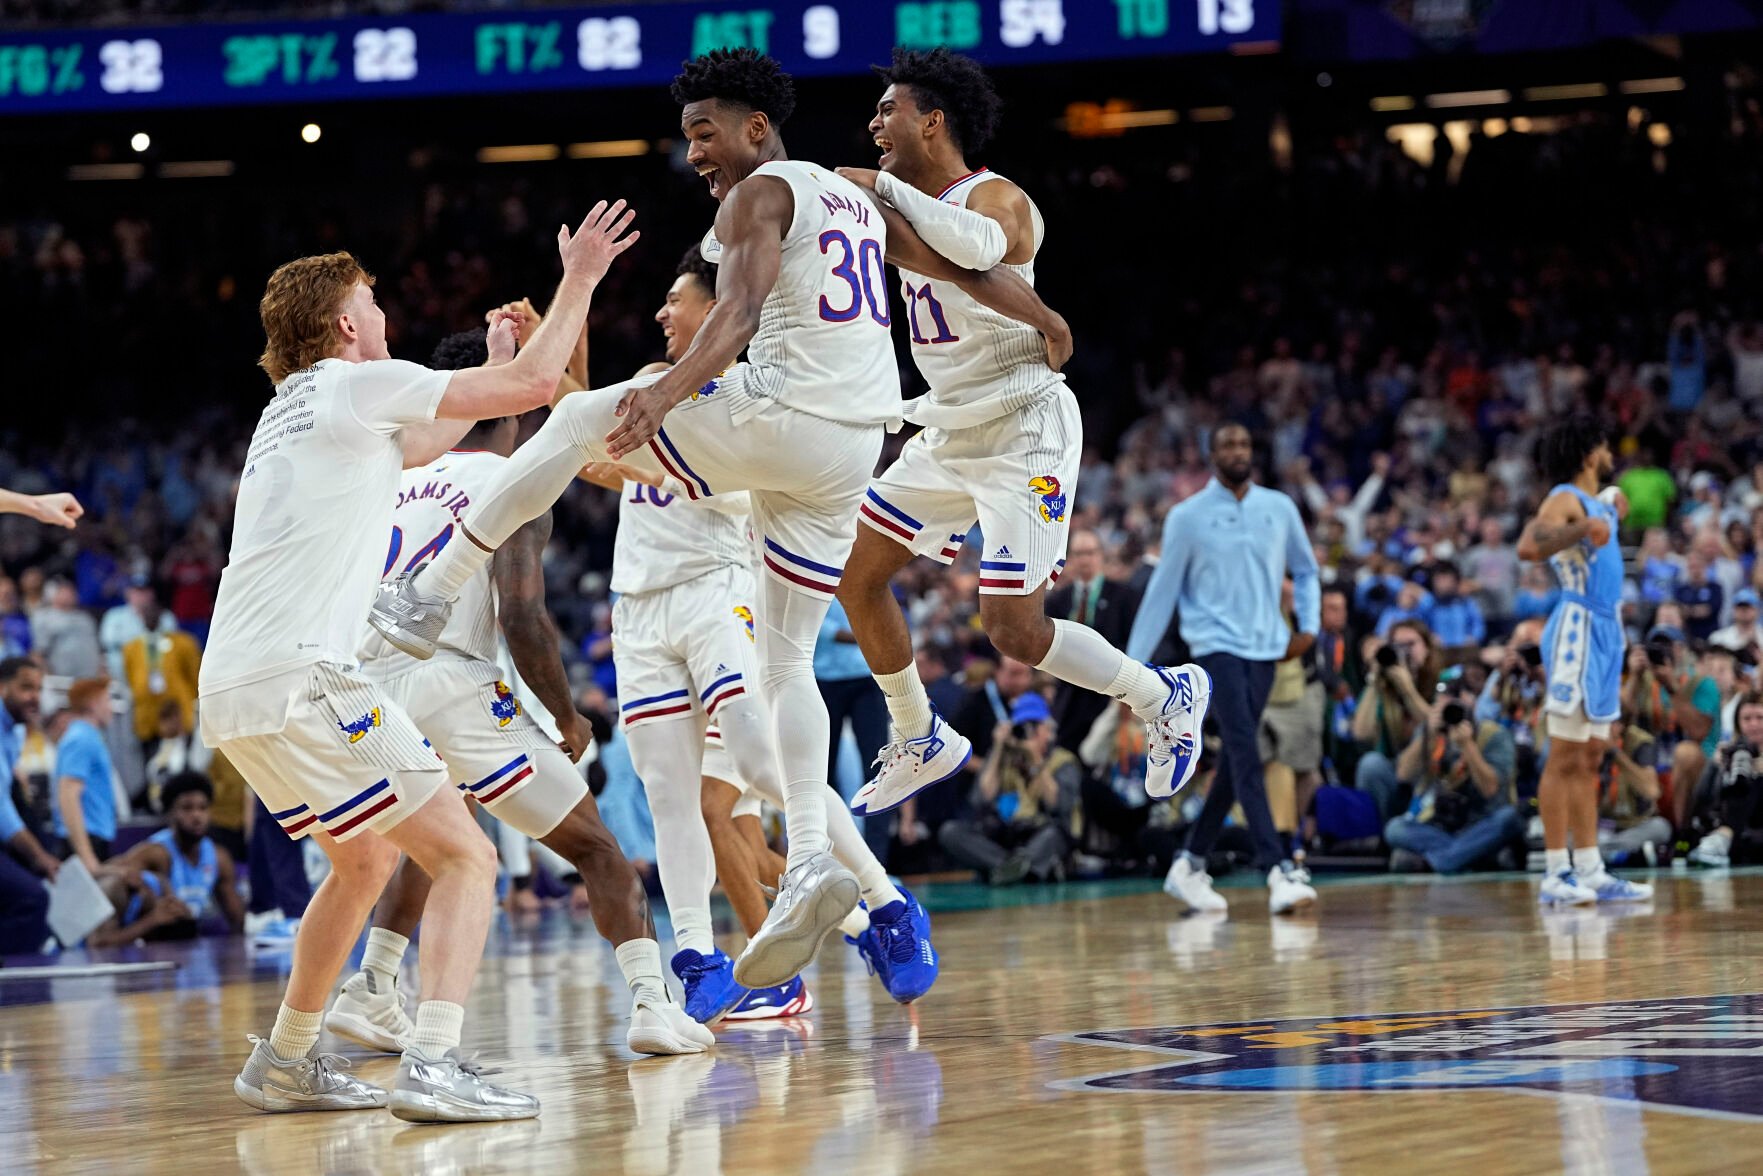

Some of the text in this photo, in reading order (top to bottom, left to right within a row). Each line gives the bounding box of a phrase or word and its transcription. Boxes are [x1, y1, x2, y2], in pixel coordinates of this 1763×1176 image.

[100, 39, 163, 93] 32
[353, 27, 418, 82] 22
[474, 21, 563, 74] FT%
[578, 16, 641, 71] 82
[692, 10, 774, 58] AST
[802, 5, 839, 59] 9
[894, 0, 982, 50] REB
[1000, 0, 1065, 47] 54
[818, 229, 891, 328] 30
[905, 280, 960, 345] 11
[298, 400, 306, 408] to
[285, 420, 314, 435] Federal
[1050, 500, 1061, 510] KU
